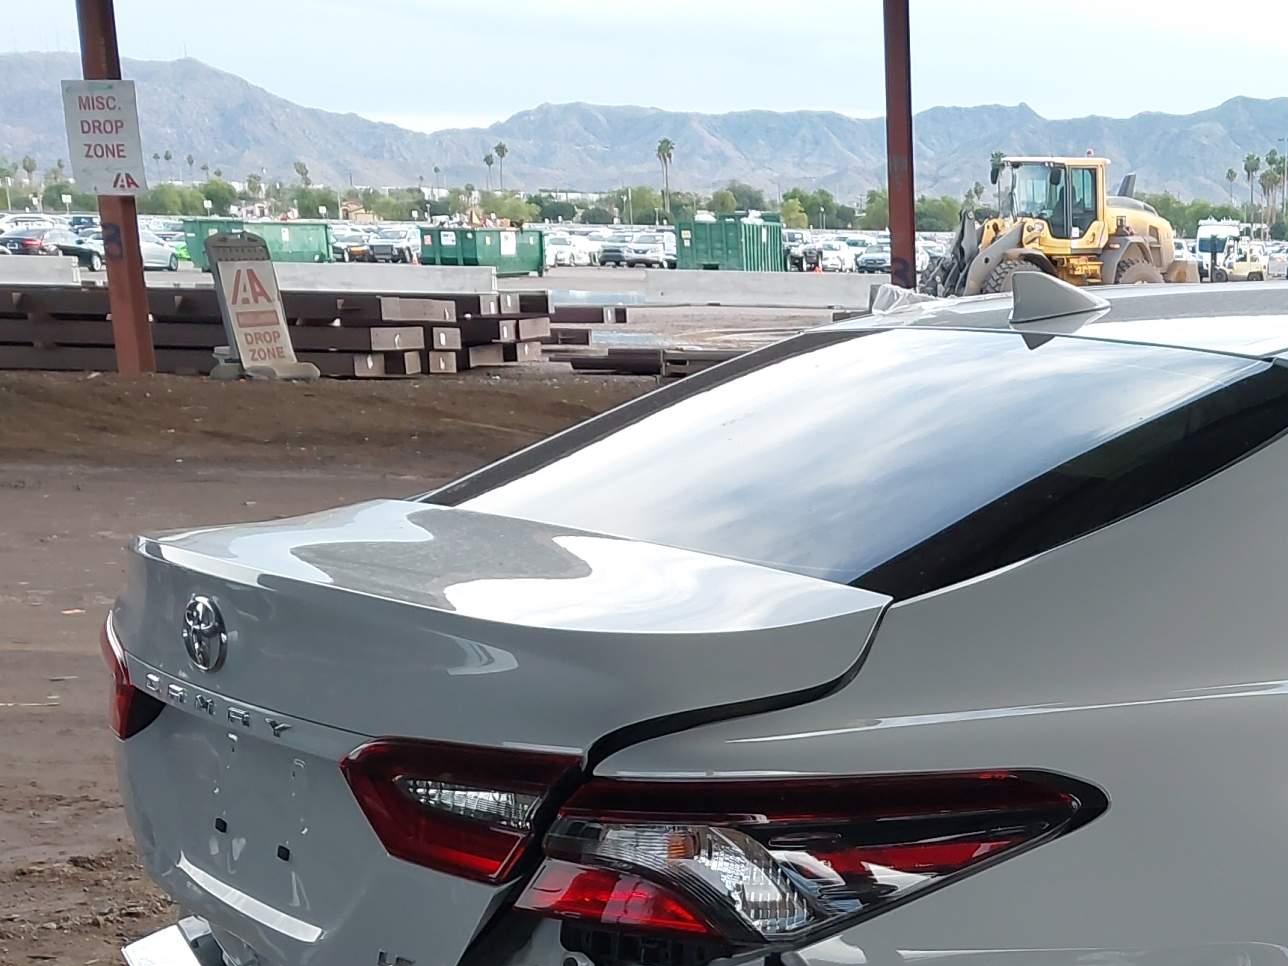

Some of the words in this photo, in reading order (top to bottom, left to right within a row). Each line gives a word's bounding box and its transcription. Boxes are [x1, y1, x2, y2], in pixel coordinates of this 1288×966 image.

[78, 95, 122, 111] MISC.
[80, 120, 124, 134] DROP
[83, 143, 127, 158] ZONE
[244, 330, 281, 345] DROP
[249, 346, 286, 361] ZONE
